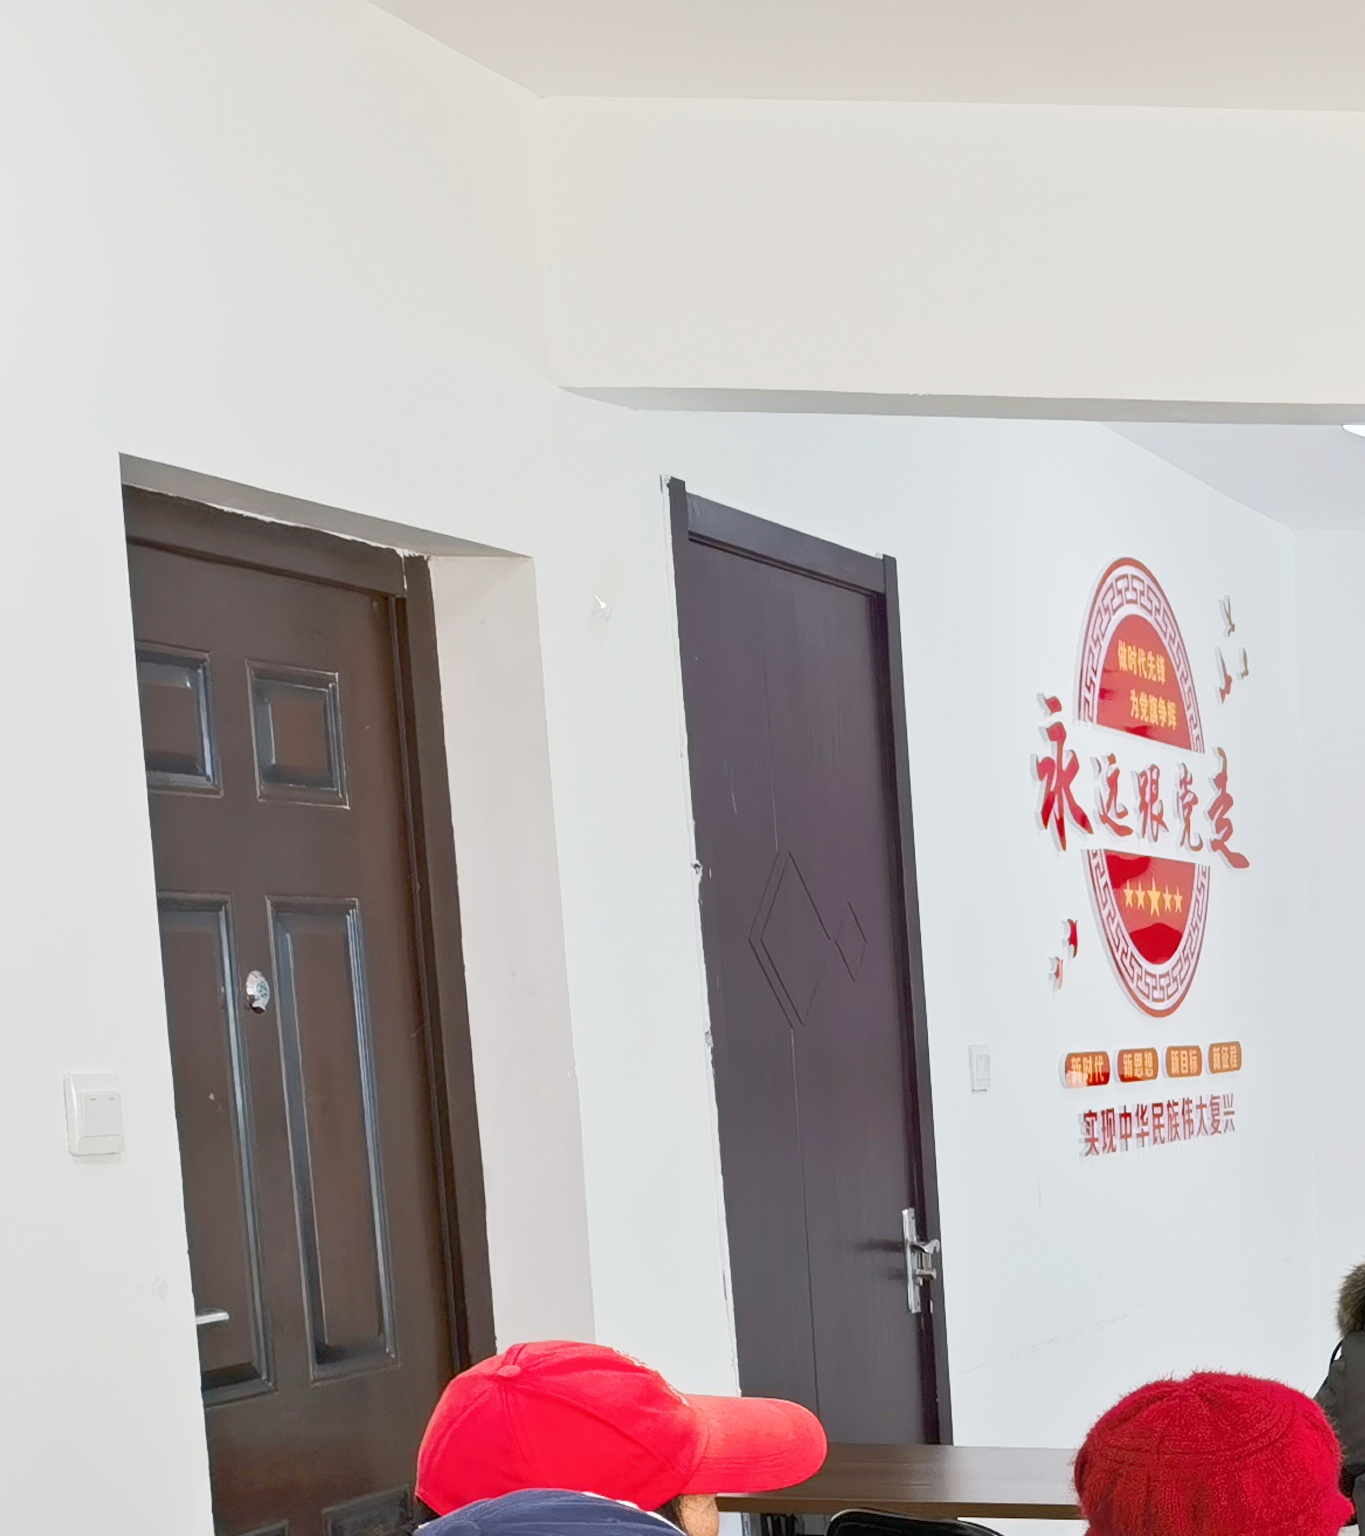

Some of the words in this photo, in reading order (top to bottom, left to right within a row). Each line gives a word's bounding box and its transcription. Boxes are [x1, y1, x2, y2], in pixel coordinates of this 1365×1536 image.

[1117, 639, 1166, 685] 做时代先锋
[1036, 693, 1250, 869] 永远跟党走
[1070, 1055, 1105, 1083] 新时代
[1123, 1051, 1154, 1078] 新思想
[1170, 1049, 1199, 1074] 新目标
[1212, 1046, 1238, 1070] 新征程
[1082, 1092, 1236, 1157] 实现中华民族伟大复兴
